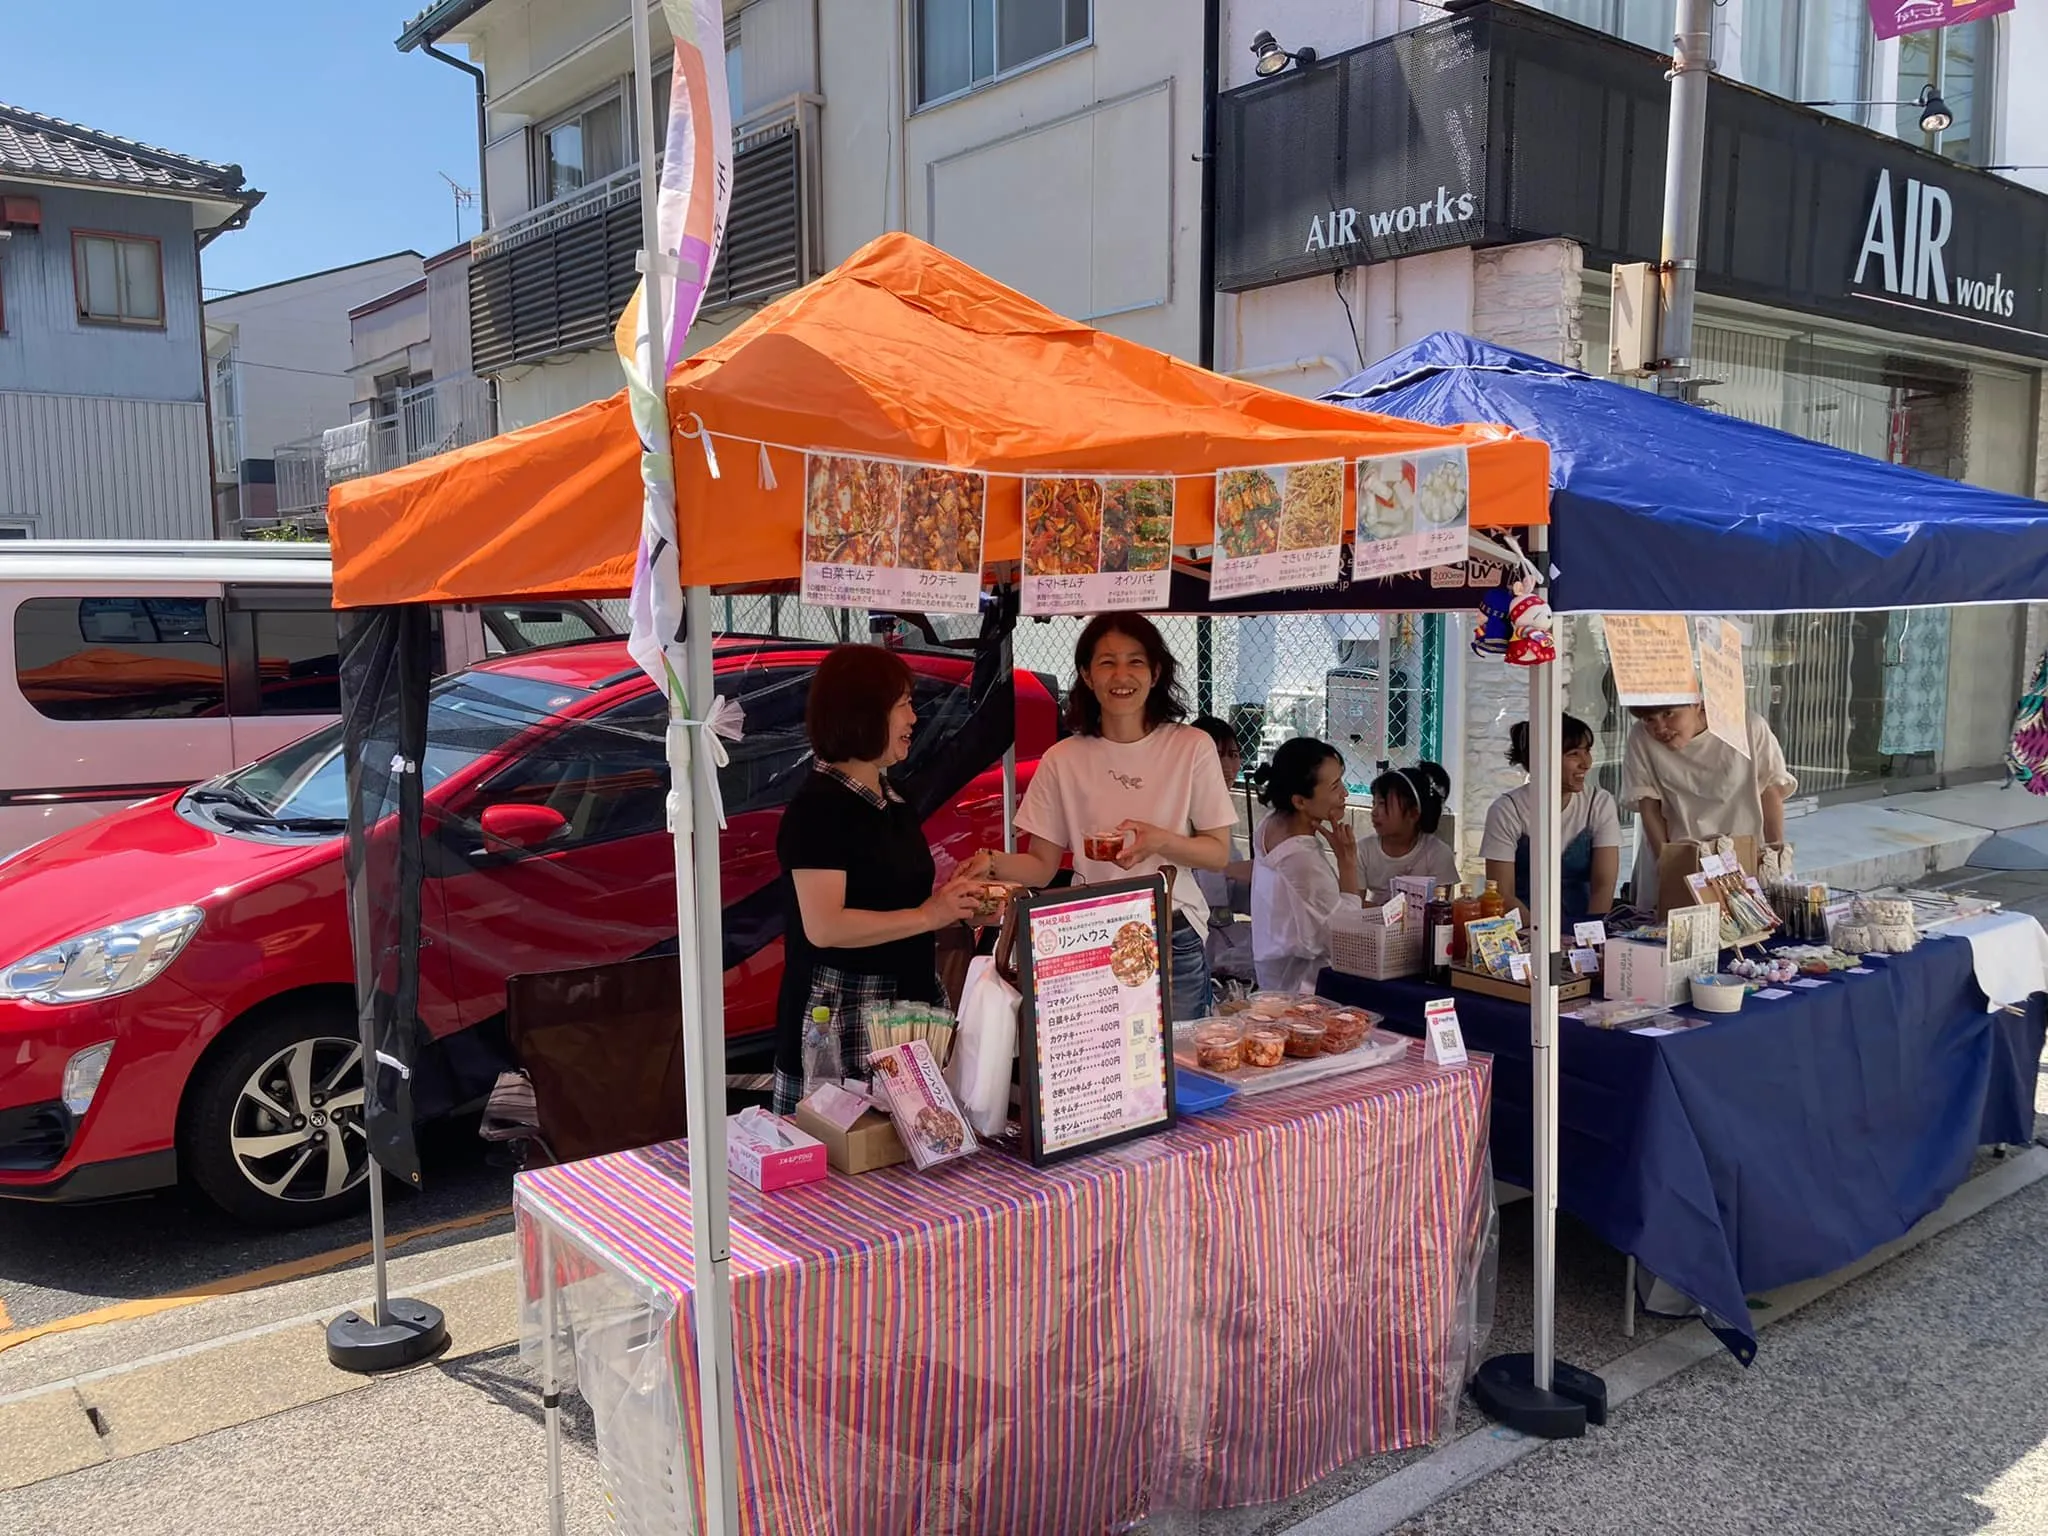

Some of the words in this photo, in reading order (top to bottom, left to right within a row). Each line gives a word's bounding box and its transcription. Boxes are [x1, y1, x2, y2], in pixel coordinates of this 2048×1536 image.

[1305, 208, 1358, 253] AIR
[1370, 186, 1477, 238] works
[1854, 168, 1952, 304] AIR
[1956, 273, 2014, 317] works
[1223, 558, 1260, 571] ネギキムチ
[1281, 549, 1334, 564] さきいかキムチ
[822, 567, 876, 581] 白菜キムチ
[919, 574, 958, 587] カクテキ
[1114, 574, 1156, 586] オイソバギ
[1472, 563, 1495, 579] UV
[1037, 578, 1086, 591] トマトキムチ
[1058, 929, 1110, 949] リンハウス
[1098, 985, 1119, 997] 500円
[1048, 1011, 1083, 1027] 白菜キムチ
[1099, 1003, 1120, 1014] 400円
[1050, 1032, 1076, 1045] カクテキ
[1100, 1020, 1120, 1032] 400円
[1050, 1046, 1085, 1063] トマトキムチ
[1101, 1038, 1121, 1049] 400円
[1050, 1066, 1083, 1080] オイソバギ
[1101, 1056, 1121, 1067] 400円
[920, 1063, 945, 1105] リンハウス
[1052, 1081, 1093, 1098] さきいかキムチ
[1102, 1074, 1121, 1085] 400円
[1053, 1102, 1080, 1117] 水キムチ
[1103, 1090, 1123, 1102] 400円
[1053, 1121, 1080, 1134] チキンム
[1103, 1108, 1122, 1120] 400円
